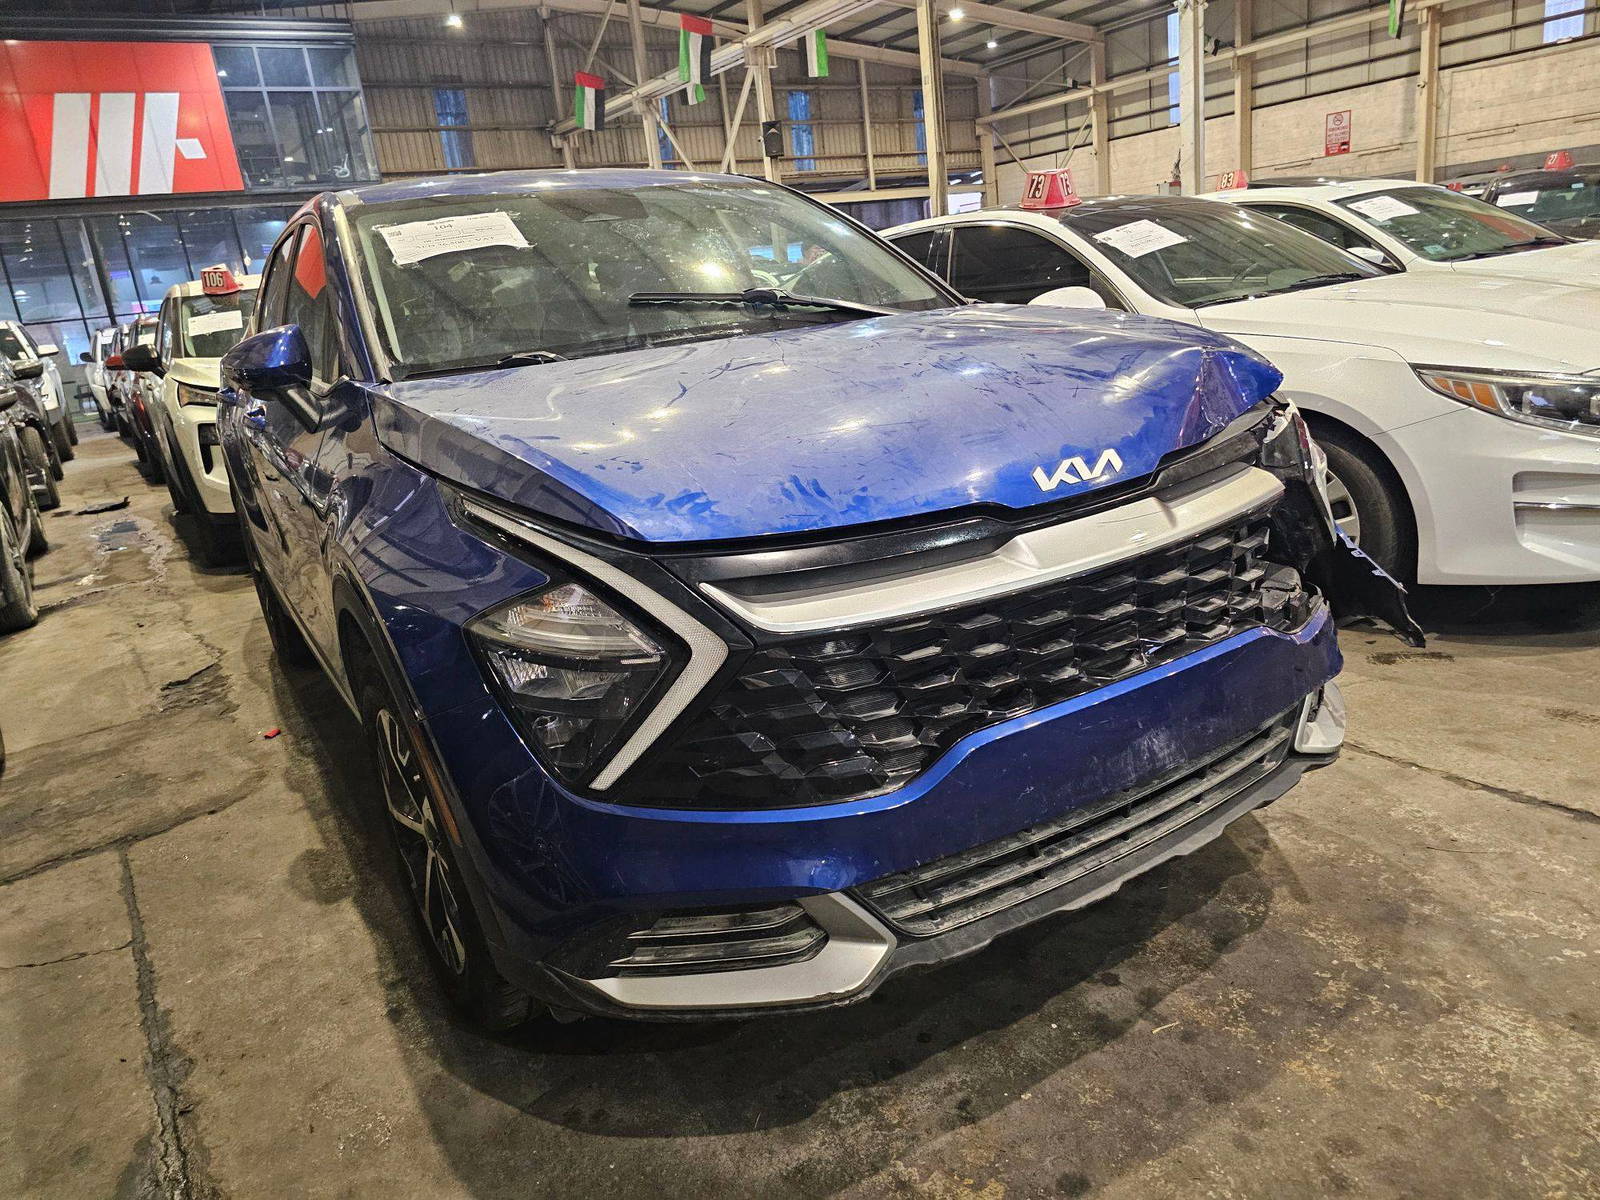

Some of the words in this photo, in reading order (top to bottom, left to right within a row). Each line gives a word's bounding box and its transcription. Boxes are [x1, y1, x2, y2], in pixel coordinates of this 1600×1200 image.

[1028, 174, 1046, 198] 73
[1059, 172, 1073, 196] 73
[1221, 172, 1234, 188] 83
[204, 272, 224, 287] 106
[1032, 448, 1123, 491] KIA
